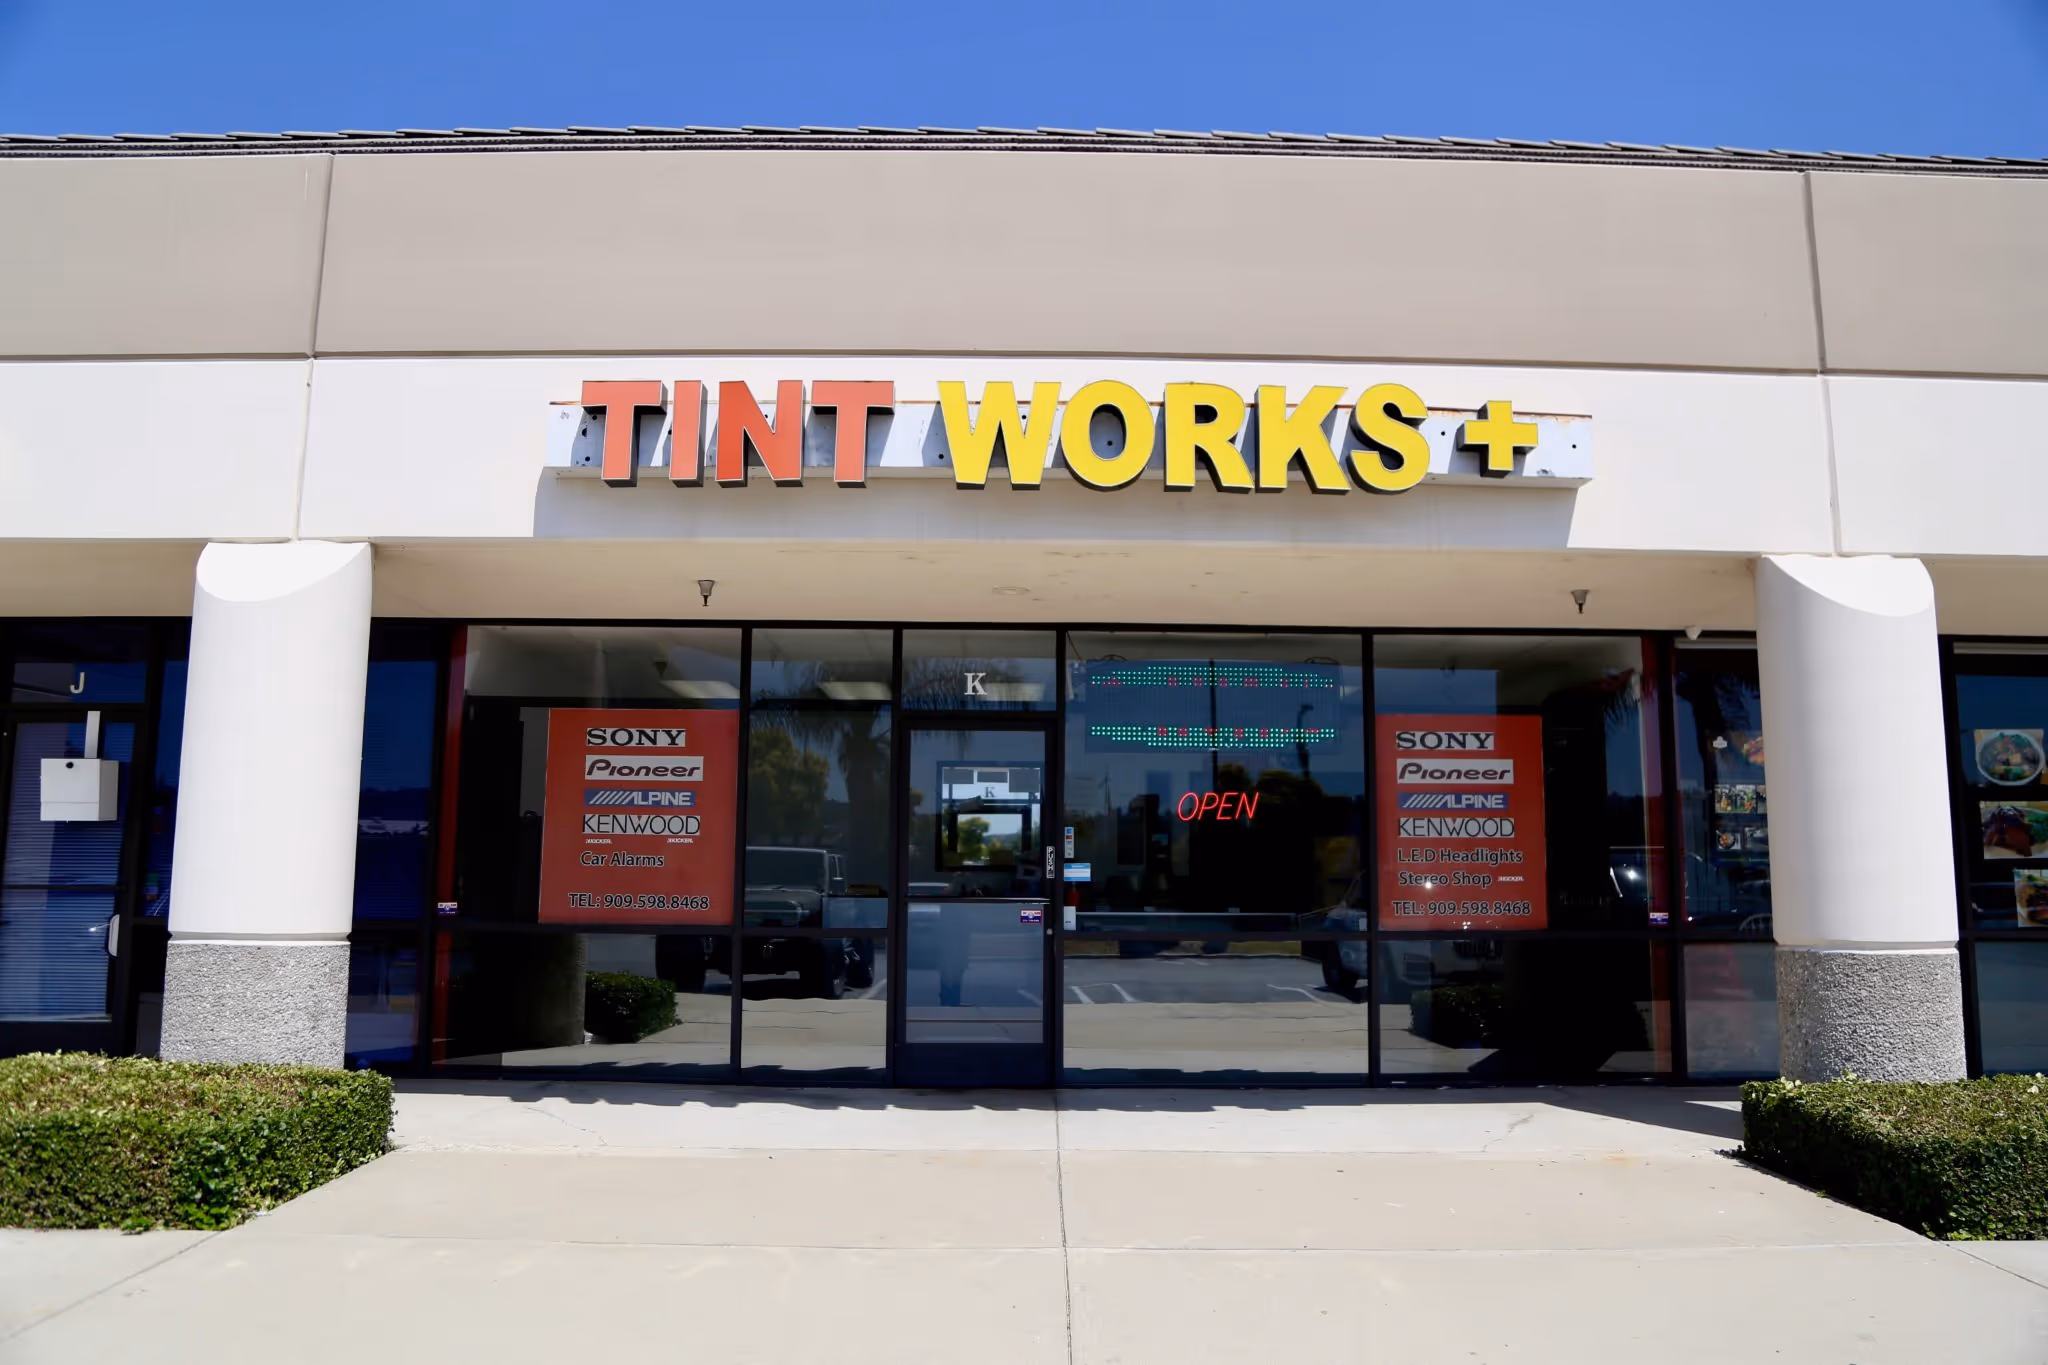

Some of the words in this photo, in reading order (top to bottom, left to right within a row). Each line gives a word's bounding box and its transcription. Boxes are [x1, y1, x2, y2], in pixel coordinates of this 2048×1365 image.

[580, 380, 895, 486] TINT
[937, 379, 1430, 492] WORKS
[70, 672, 85, 694] J
[964, 672, 988, 695] K
[586, 728, 686, 746] SONY
[1396, 731, 1494, 749] SONY
[586, 758, 701, 777] Pioneer
[1399, 762, 1511, 780] Pioneer
[622, 790, 692, 806] ALPINE
[1176, 791, 1260, 821] OPEN
[1436, 794, 1504, 808] ALPINE
[583, 814, 700, 835] KENWOOD
[1398, 817, 1515, 837] KENWOOD
[580, 851, 607, 865] Car
[610, 851, 665, 867] Alarms
[1398, 848, 1436, 863] L.E.D
[1439, 848, 1523, 866] Headlights
[1399, 871, 1448, 887] Stereo
[1452, 871, 1492, 889] Shop
[568, 892, 600, 908] TEL:
[604, 894, 710, 910] 909.598.8468
[1393, 901, 1425, 915] TEL:
[1428, 901, 1532, 916] 909.598.8468
